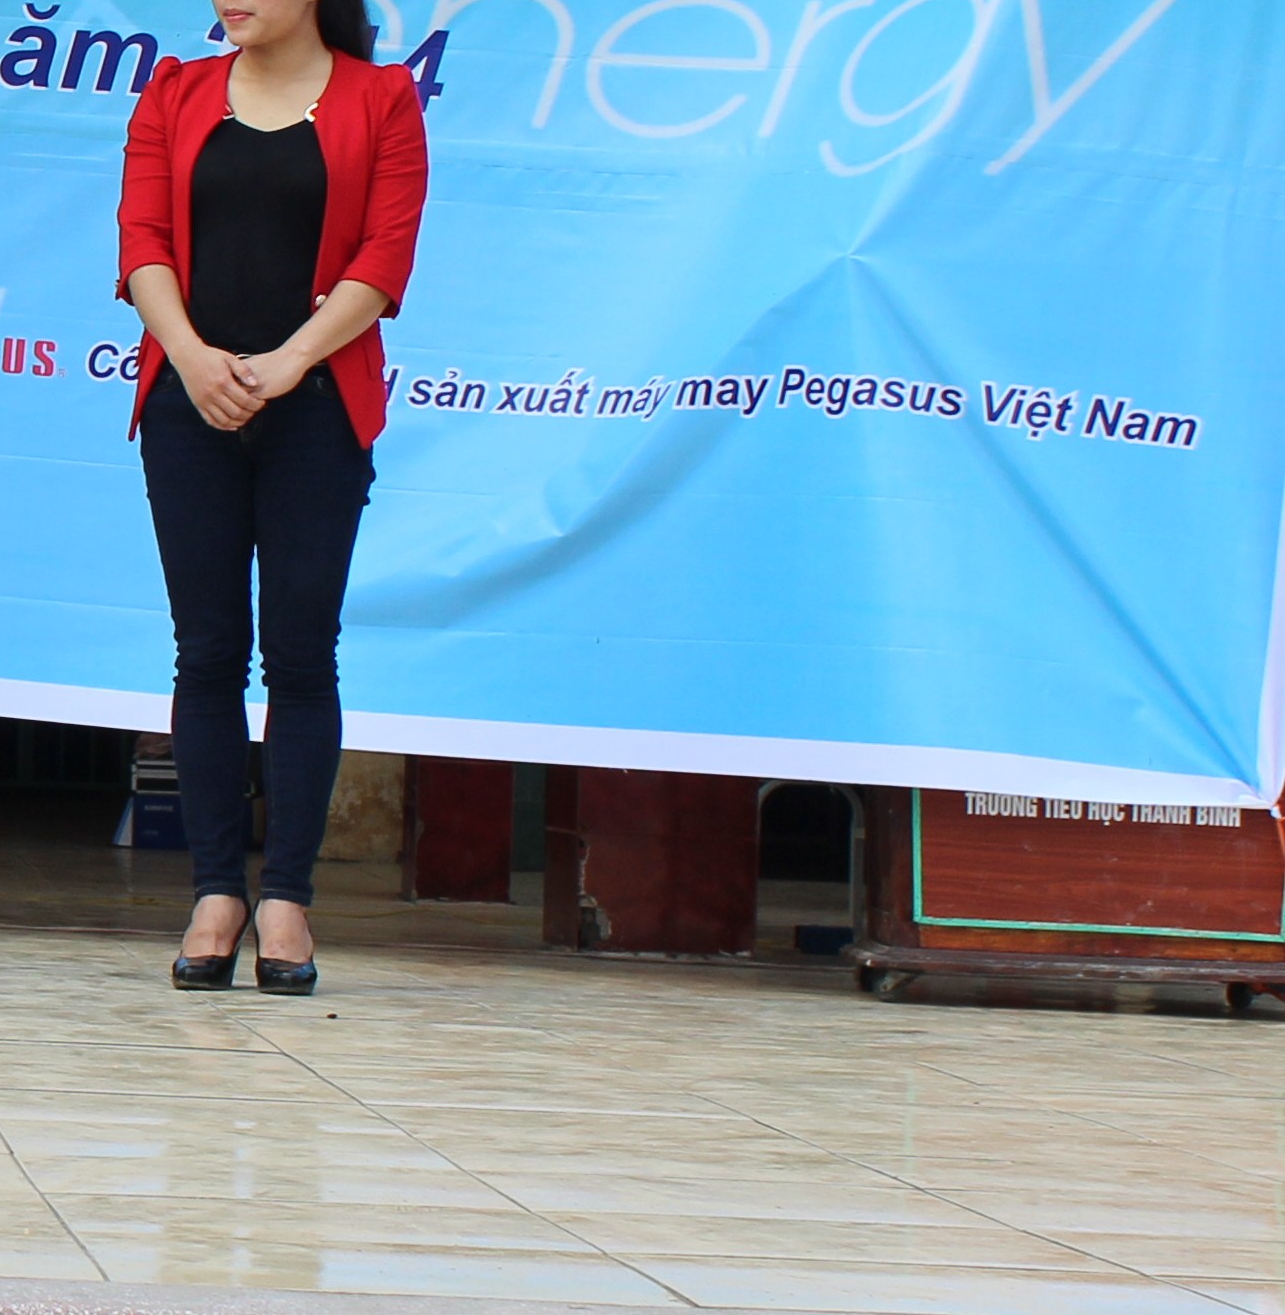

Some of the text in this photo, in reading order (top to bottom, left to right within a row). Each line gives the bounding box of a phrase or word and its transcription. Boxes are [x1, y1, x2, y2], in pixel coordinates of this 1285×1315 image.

[407, 370, 487, 410] sản
[494, 368, 593, 416] xuất
[597, 376, 671, 421] máy
[672, 373, 772, 418] may
[776, 364, 967, 419] Pegasus
[981, 380, 1076, 441] Việt
[1081, 395, 1201, 450] Nam
